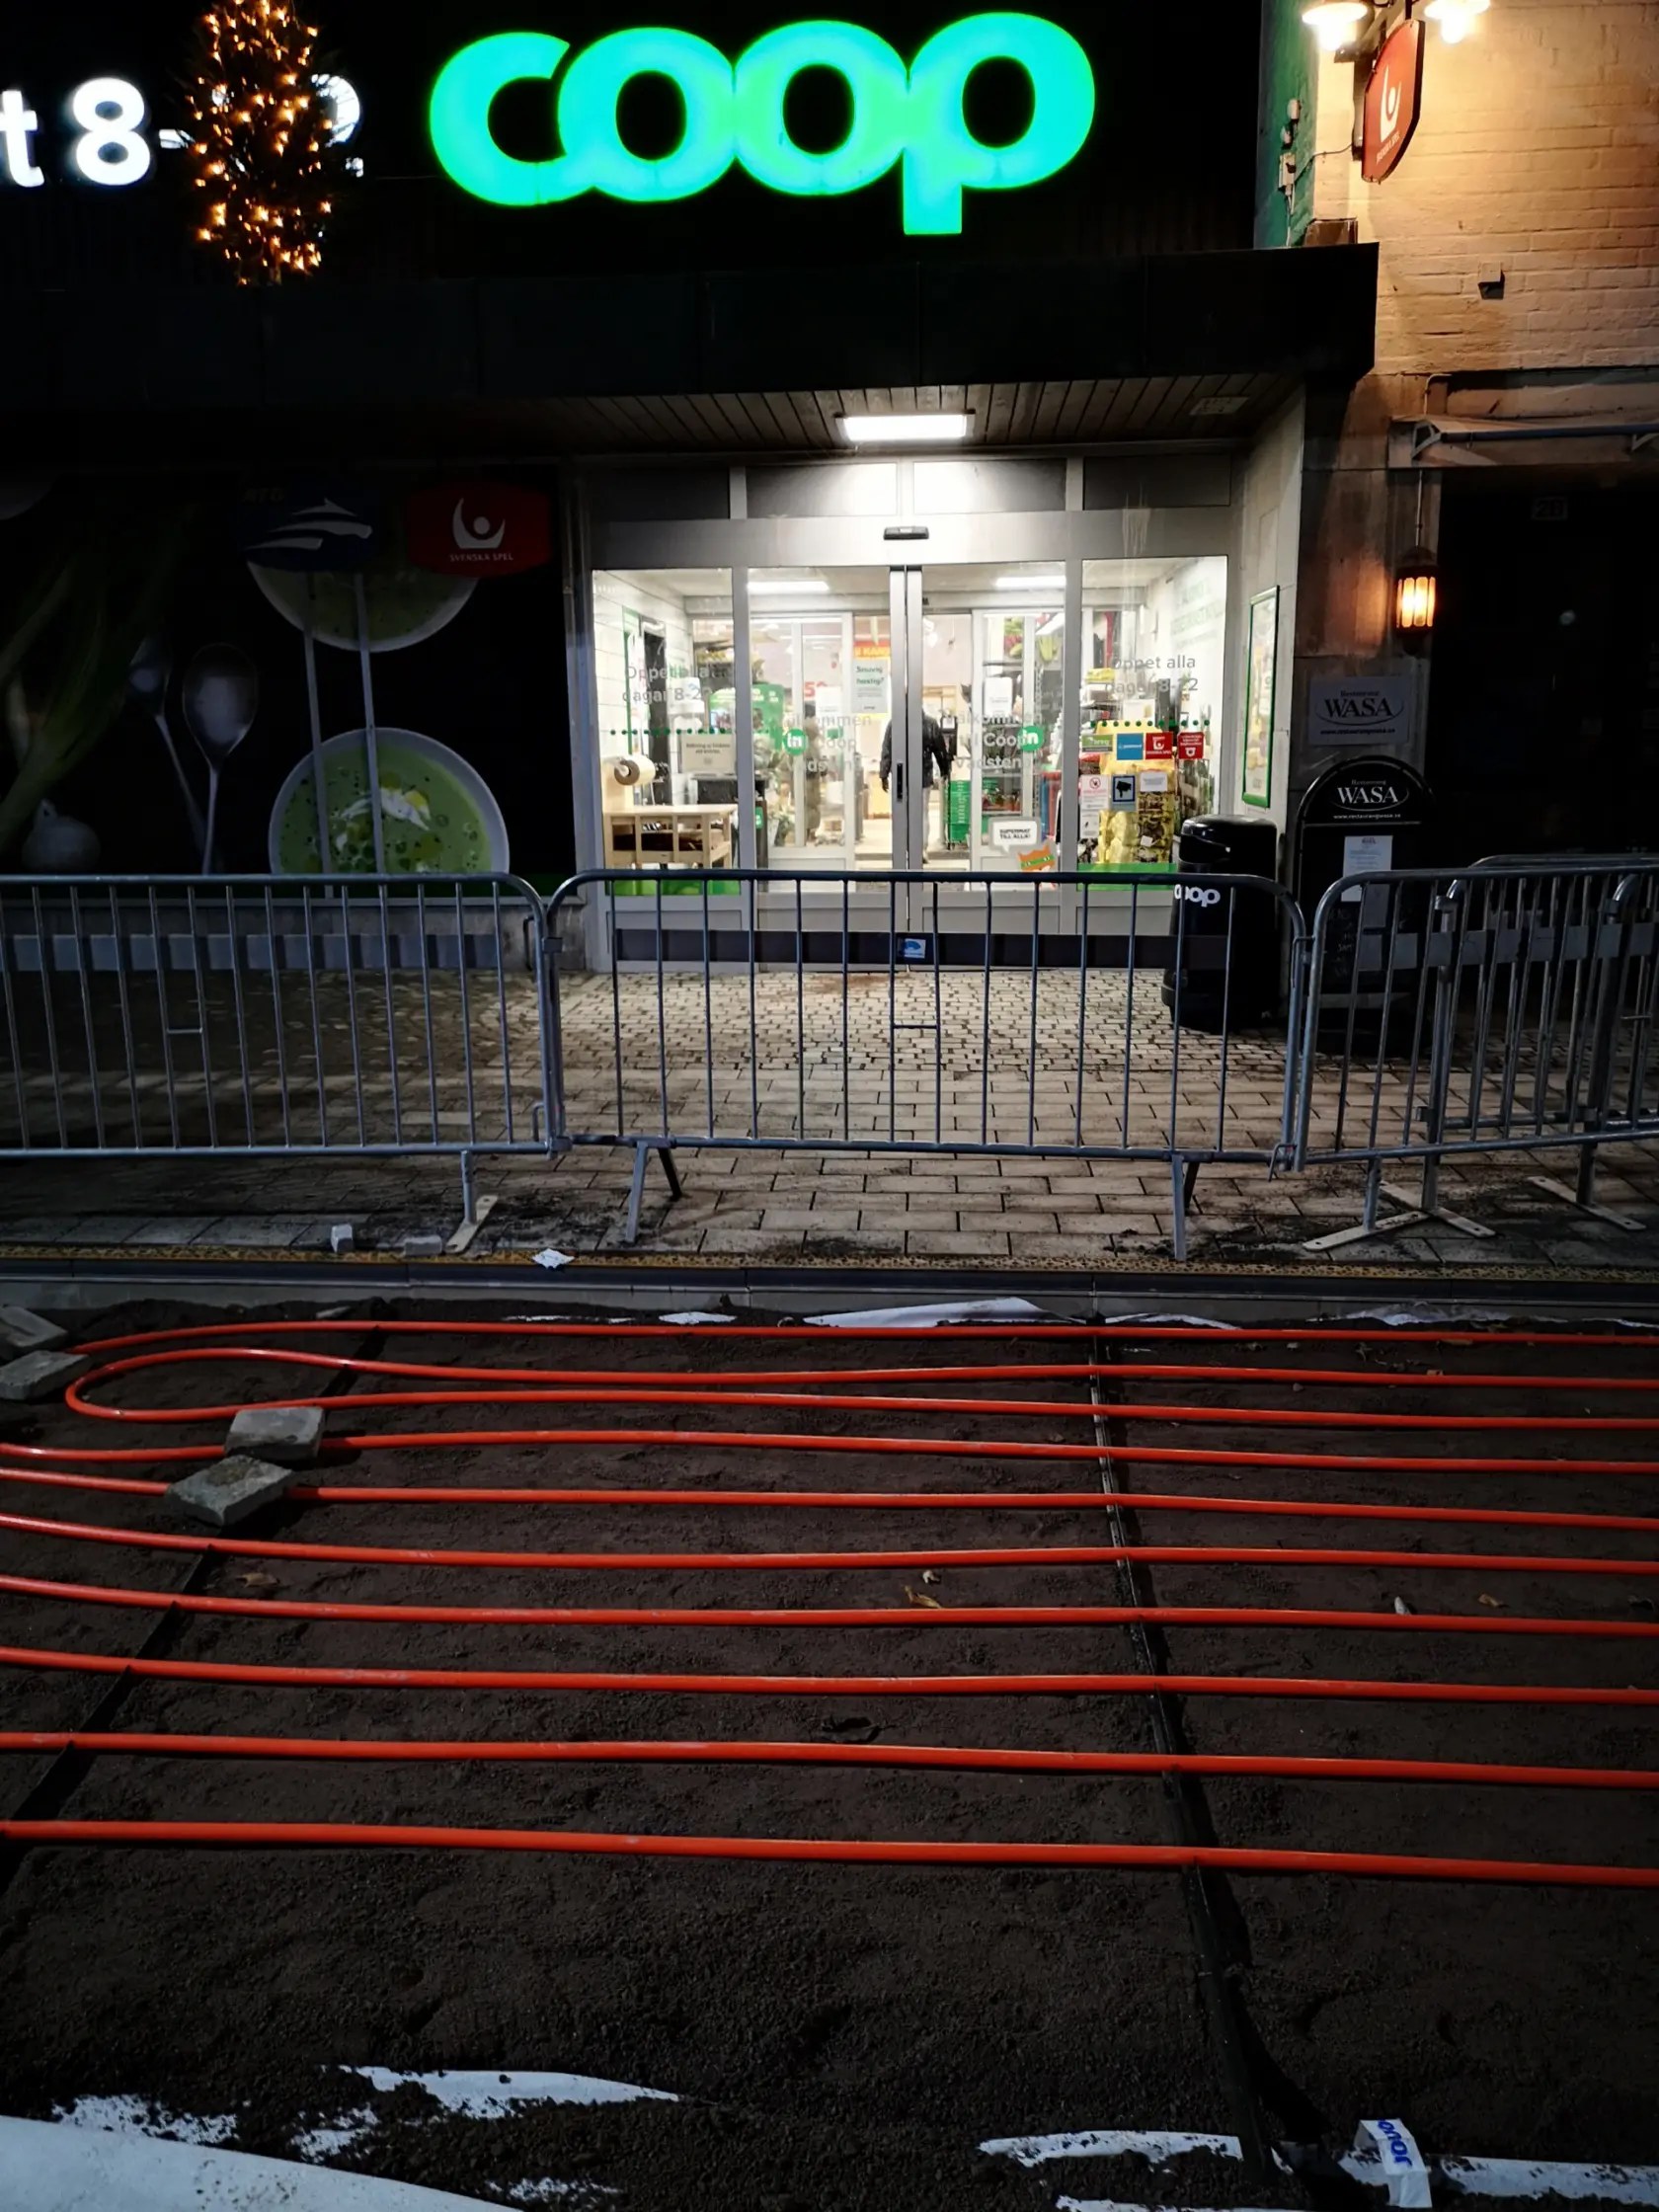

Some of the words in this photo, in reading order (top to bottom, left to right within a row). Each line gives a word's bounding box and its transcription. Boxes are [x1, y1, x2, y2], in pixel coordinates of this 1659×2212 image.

[72, 75, 364, 187] 8-
[430, 12, 1095, 234] coop
[449, 552, 491, 562] SVENSKA
[493, 551, 514, 561] SPEL
[1166, 654, 1196, 669] alla
[1324, 697, 1393, 718] WASA
[984, 733, 1026, 750] Coop
[1021, 730, 1040, 746] in
[1336, 785, 1399, 805] WASA
[1377, 2119, 1413, 2168] onor
